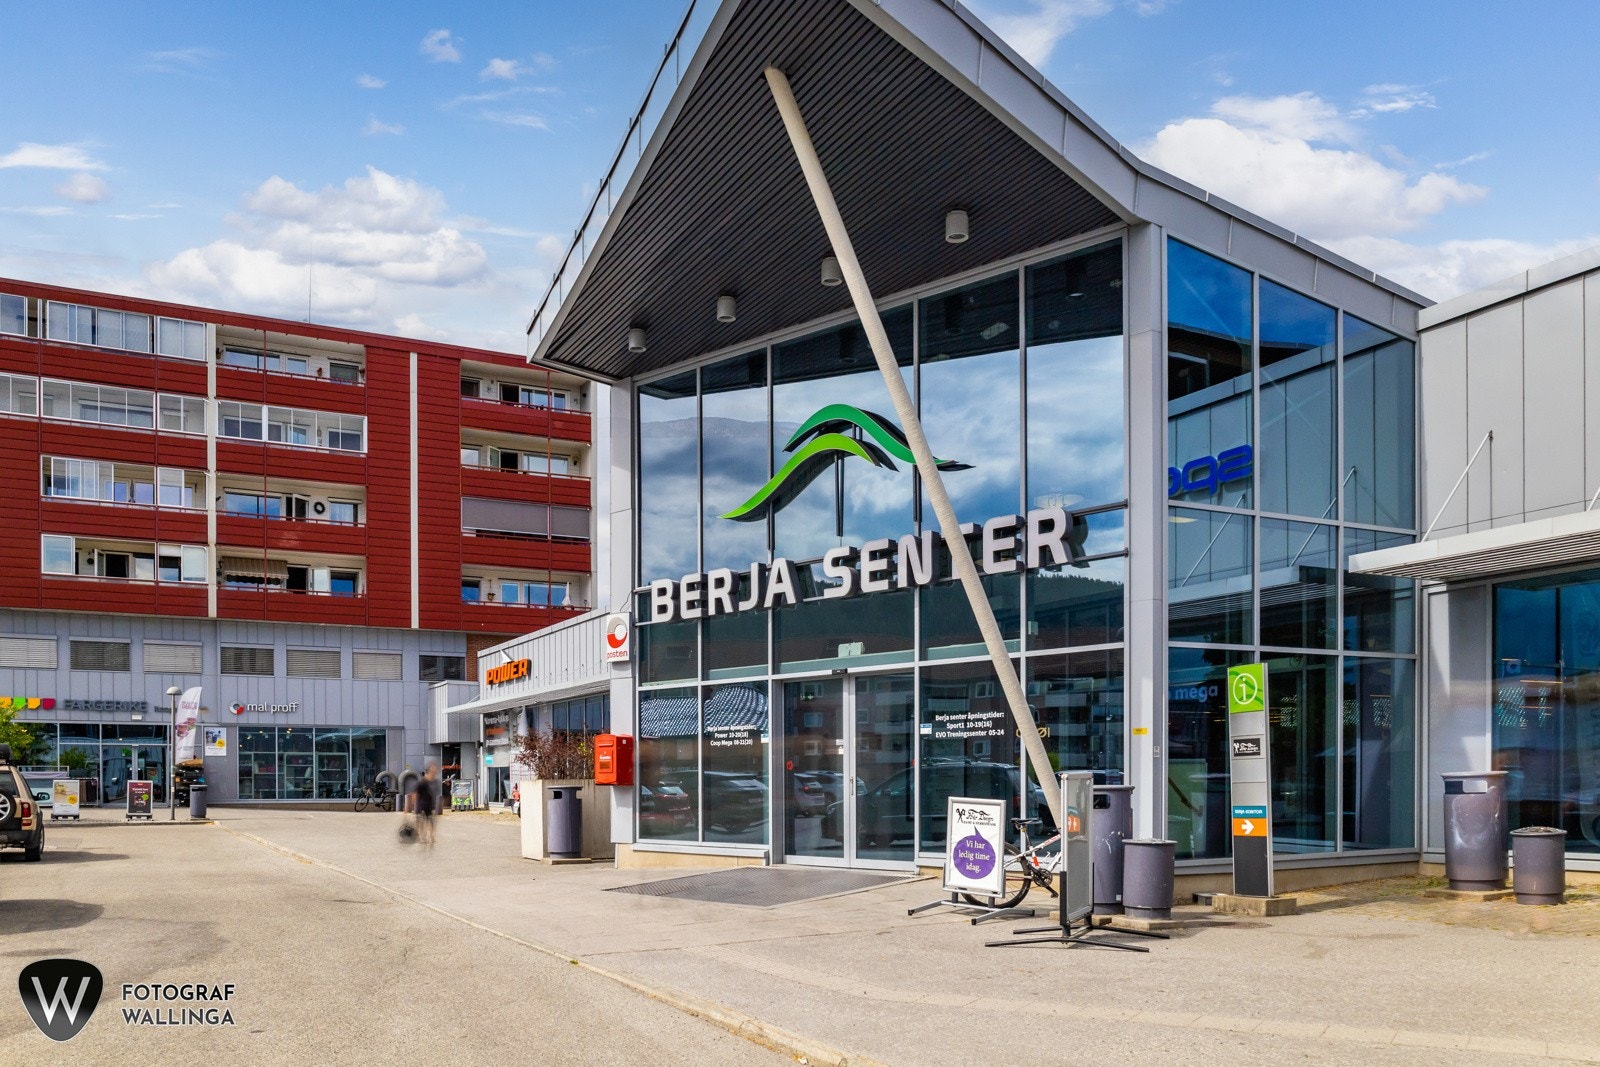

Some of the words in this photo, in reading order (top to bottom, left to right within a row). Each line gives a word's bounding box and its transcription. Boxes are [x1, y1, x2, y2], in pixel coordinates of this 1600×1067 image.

[651, 557, 800, 624] BERJA
[607, 650, 628, 659] posten
[486, 659, 531, 685] POWER
[1175, 685, 1218, 703] mega
[64, 699, 148, 713] FARGERIKE
[247, 701, 267, 712] mal
[270, 701, 299, 715] proff
[950, 713, 967, 721] senter
[967, 711, 1005, 721] åpningstider:
[947, 729, 987, 738] Treningssenter
[966, 840, 973, 848] Vi
[974, 840, 986, 850] har
[958, 850, 974, 861] ledig
[975, 851, 990, 861] time
[965, 863, 982, 873] idag.
